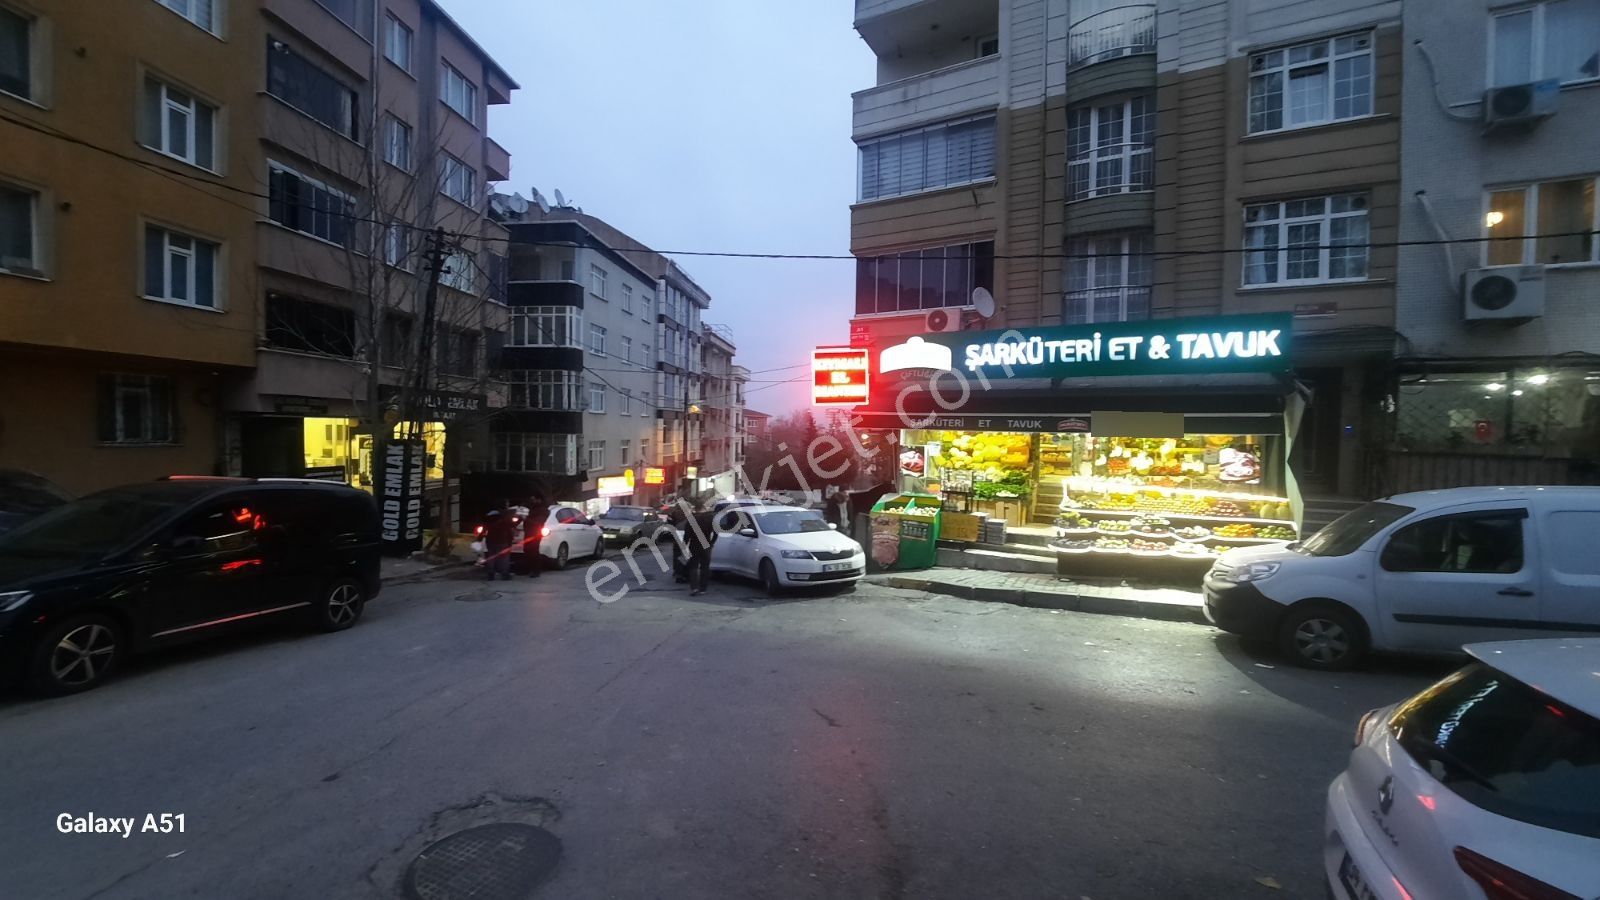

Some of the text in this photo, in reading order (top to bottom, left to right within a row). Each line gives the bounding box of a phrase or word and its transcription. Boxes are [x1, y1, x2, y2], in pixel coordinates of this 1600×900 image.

[964, 329, 1282, 371] ŞARKÜTERİ ET & TAVUK
[978, 419, 991, 429] ET
[1008, 418, 1042, 429] TAVUK
[381, 443, 404, 541] GOLD EMLAK
[408, 443, 425, 496] EMLAK
